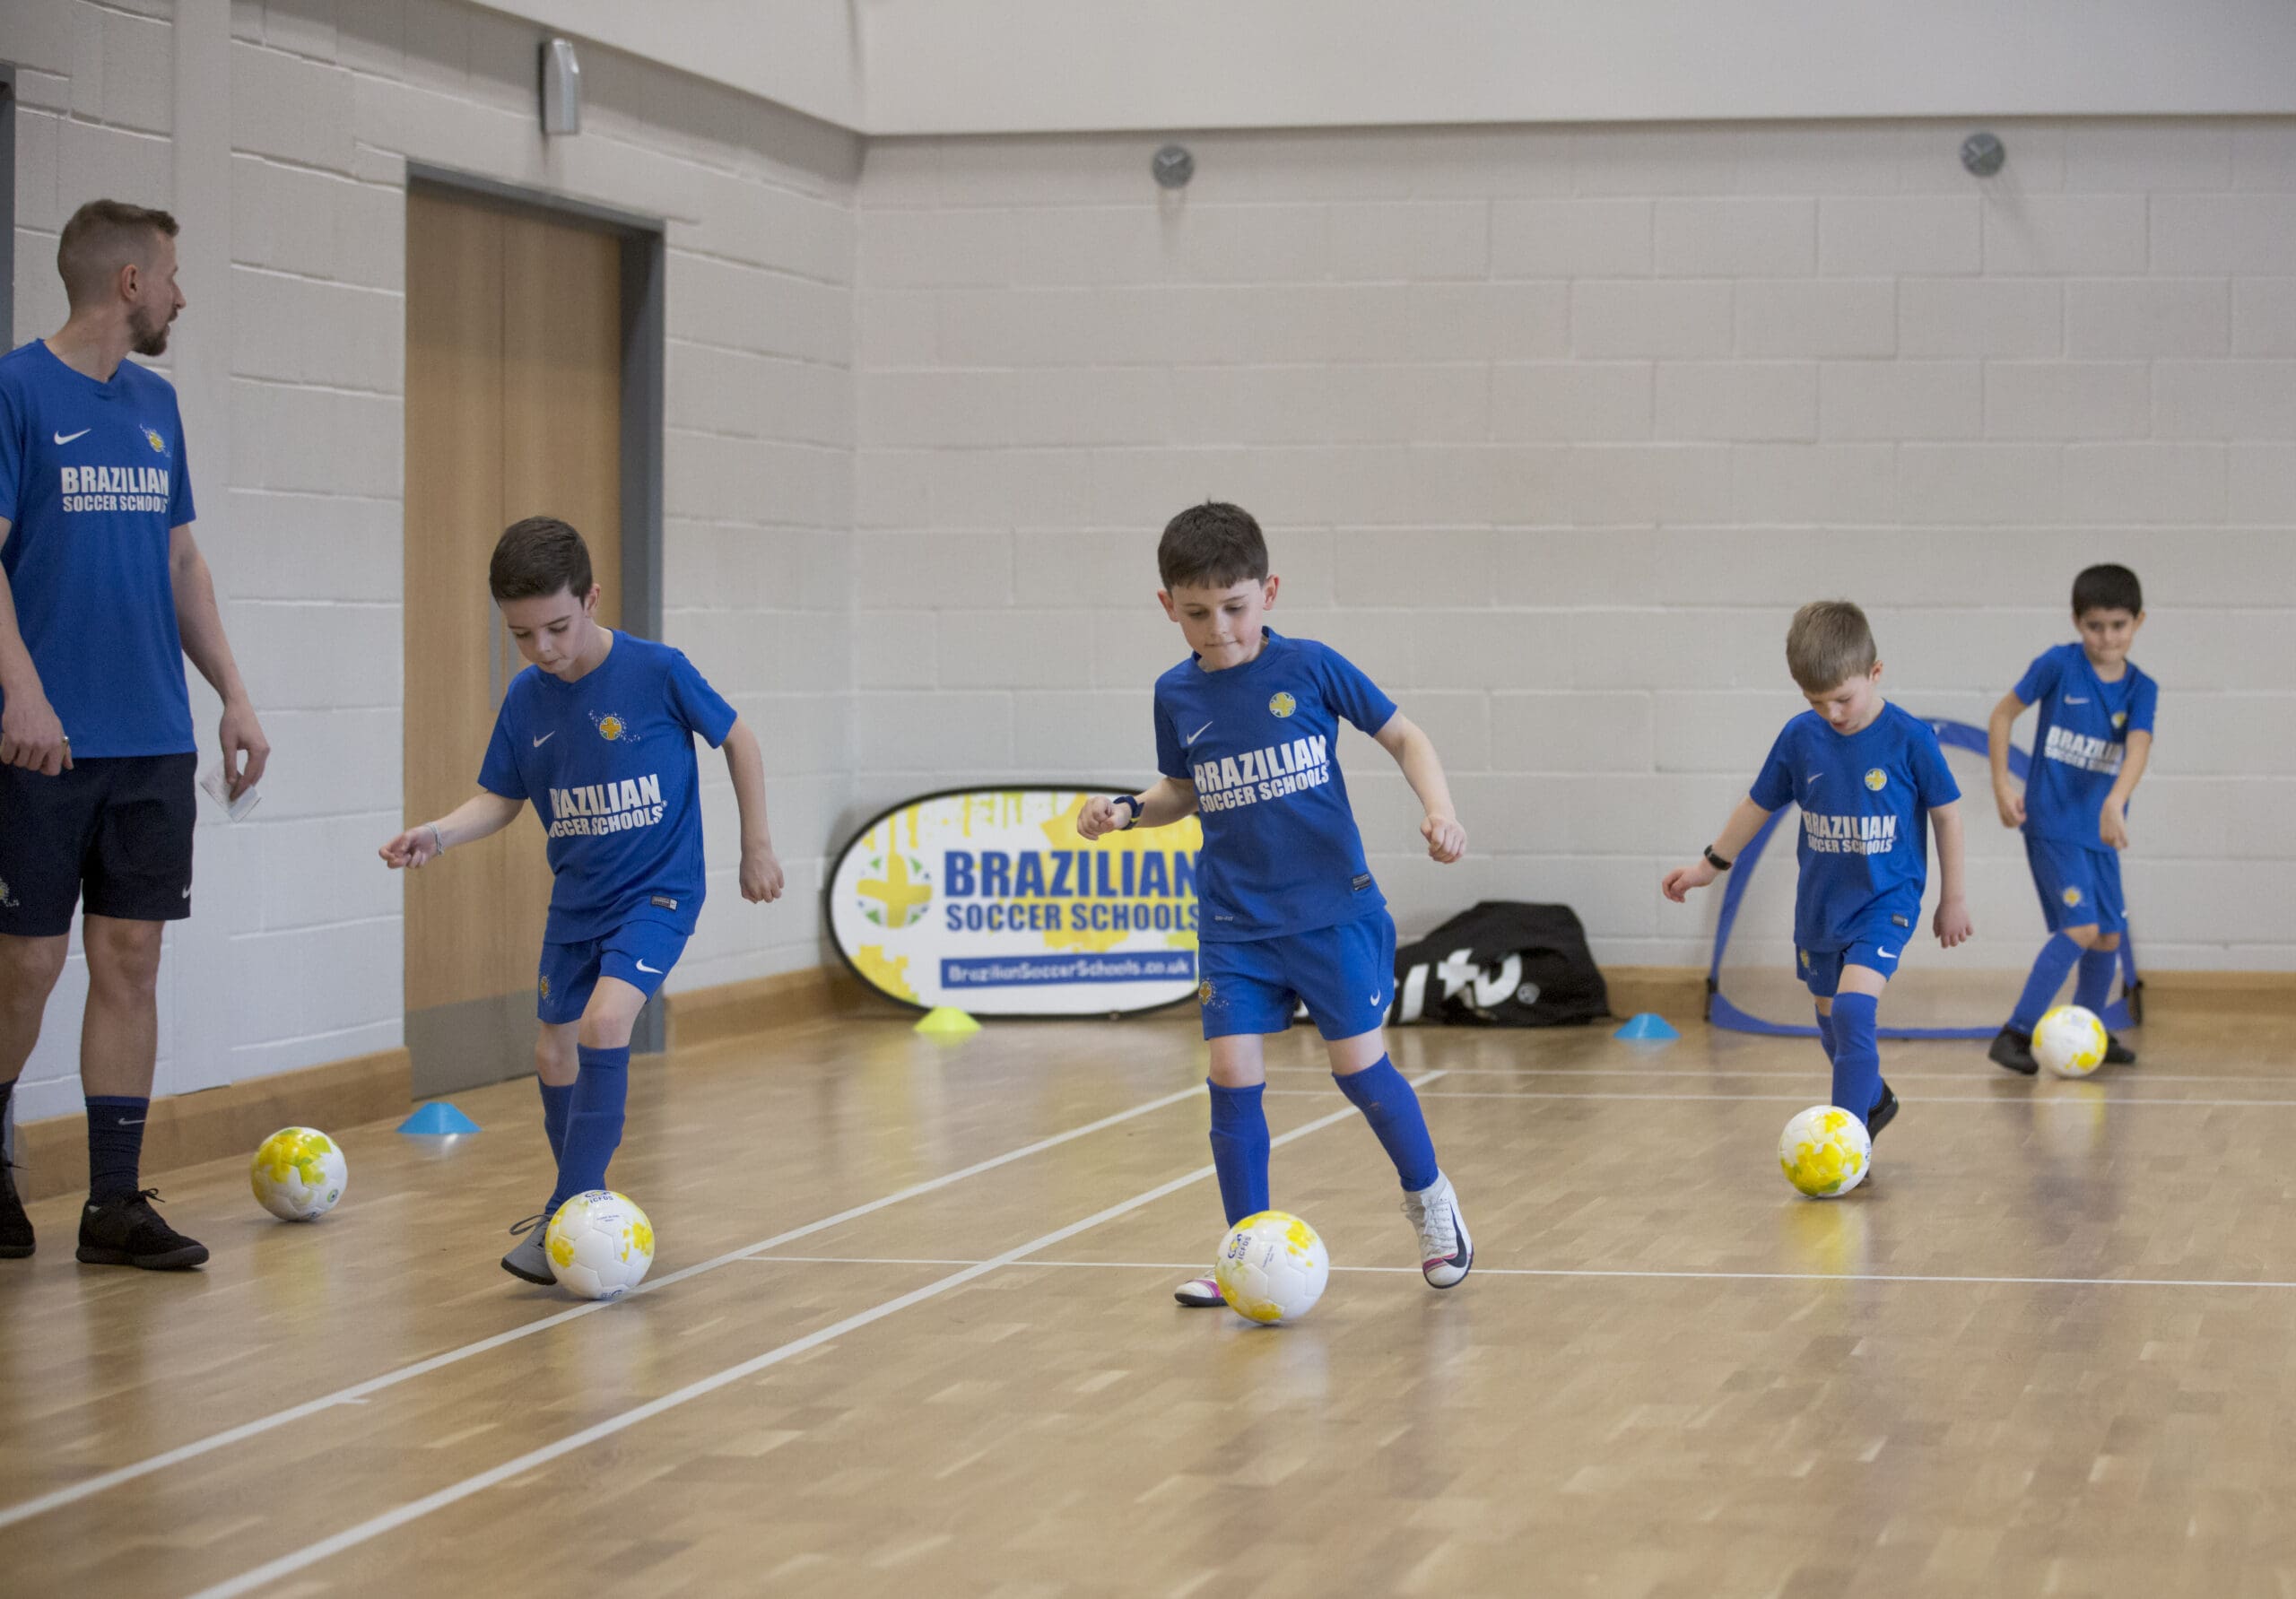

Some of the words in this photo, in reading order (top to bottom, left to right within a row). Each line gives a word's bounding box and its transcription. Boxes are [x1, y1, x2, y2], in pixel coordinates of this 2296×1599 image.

[61, 466, 169, 496] BRAZILIAN
[63, 495, 117, 512] SOCCER
[1194, 734, 1326, 794] BRAZILIAN
[1200, 786, 1257, 813] SOCCER
[1258, 765, 1329, 801] SCHOOLS
[592, 805, 663, 836] SCHOOLS
[1802, 811, 1897, 840] BRAZILIAN
[1842, 839, 1892, 856] SCHOOLS
[944, 851, 1199, 898] BRAZILIAN
[946, 903, 1061, 931] SOCCER
[1071, 903, 1199, 932] SCHOOLS
